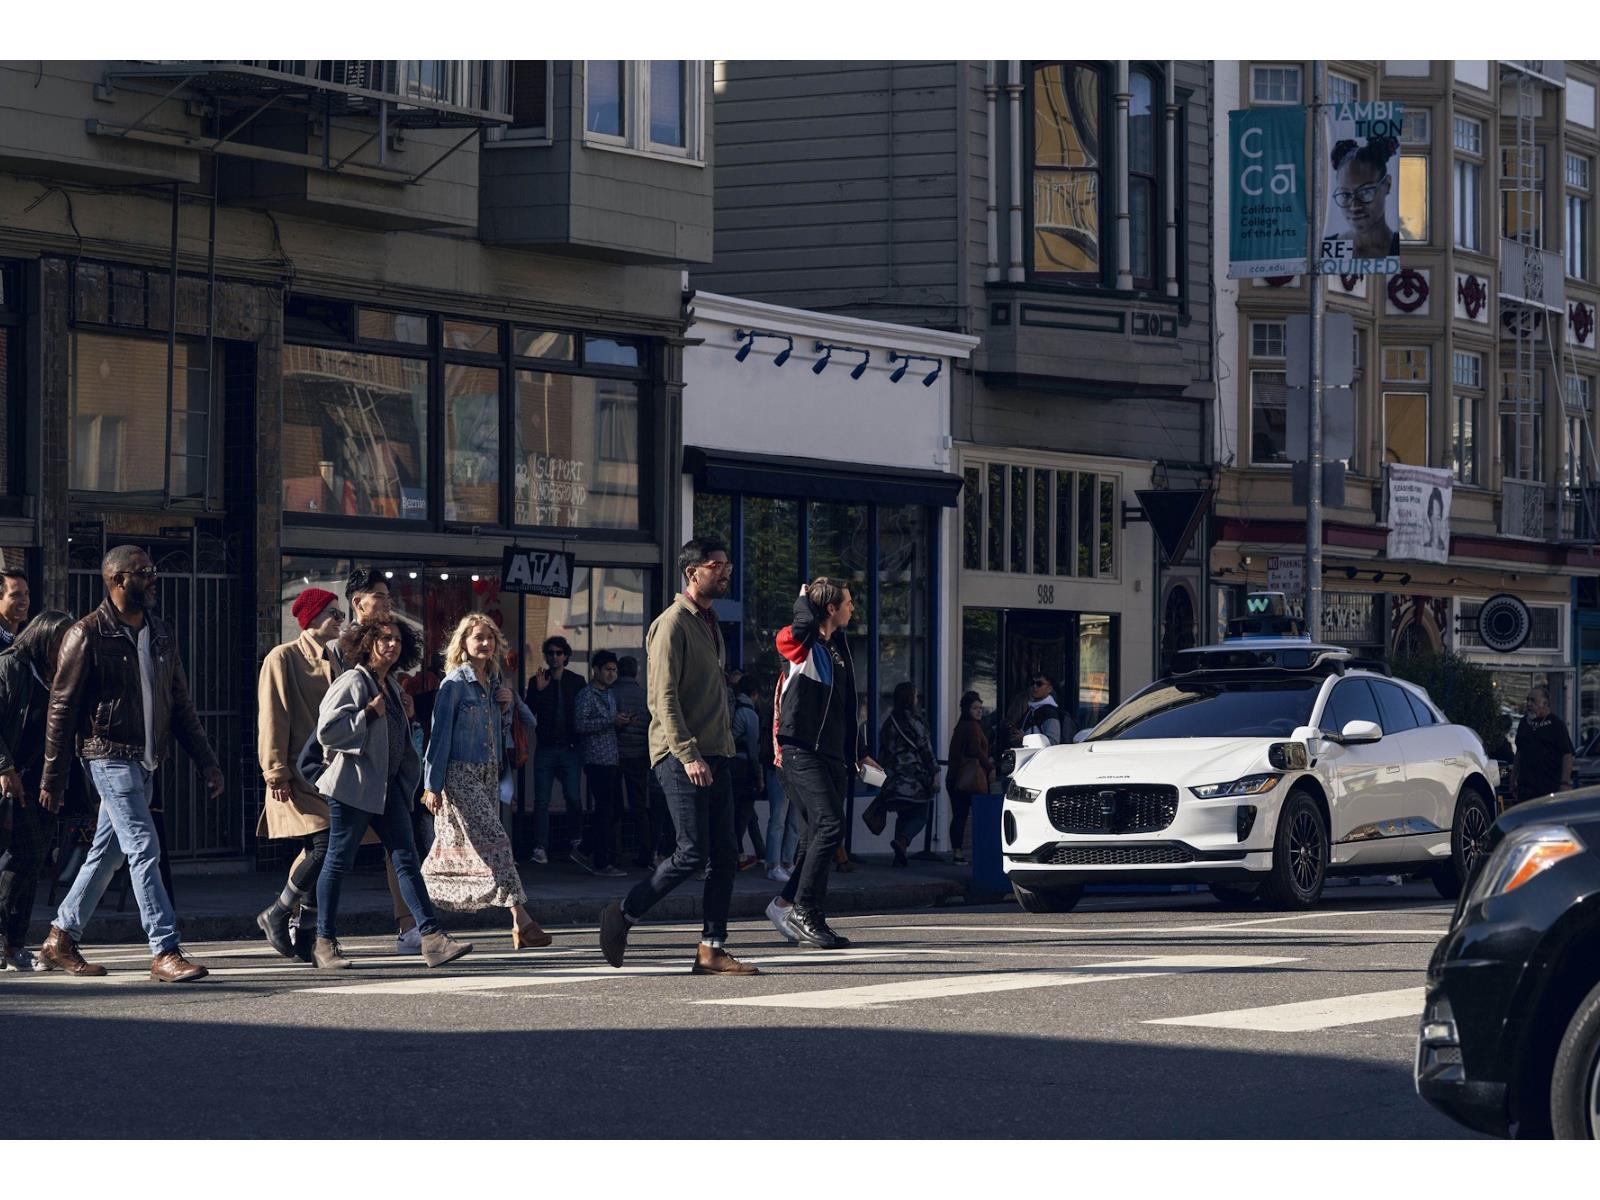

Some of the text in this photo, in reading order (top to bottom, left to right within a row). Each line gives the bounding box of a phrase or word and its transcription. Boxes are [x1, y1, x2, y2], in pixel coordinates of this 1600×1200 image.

[1339, 102, 1403, 120] AMBI-
[1355, 120, 1403, 138] TION
[1240, 127, 1263, 158] C
[1240, 204, 1293, 215] California
[1240, 216, 1278, 228] College
[1240, 227, 1296, 239] of the Arts
[1321, 241, 1354, 258] RE-
[1248, 263, 1286, 274] cca.edu
[1320, 258, 1400, 275] QUIRED
[402, 496, 426, 509] Bernie
[506, 552, 569, 588] ATA
[1280, 559, 1301, 568] PARKING
[1037, 584, 1054, 604] 988
